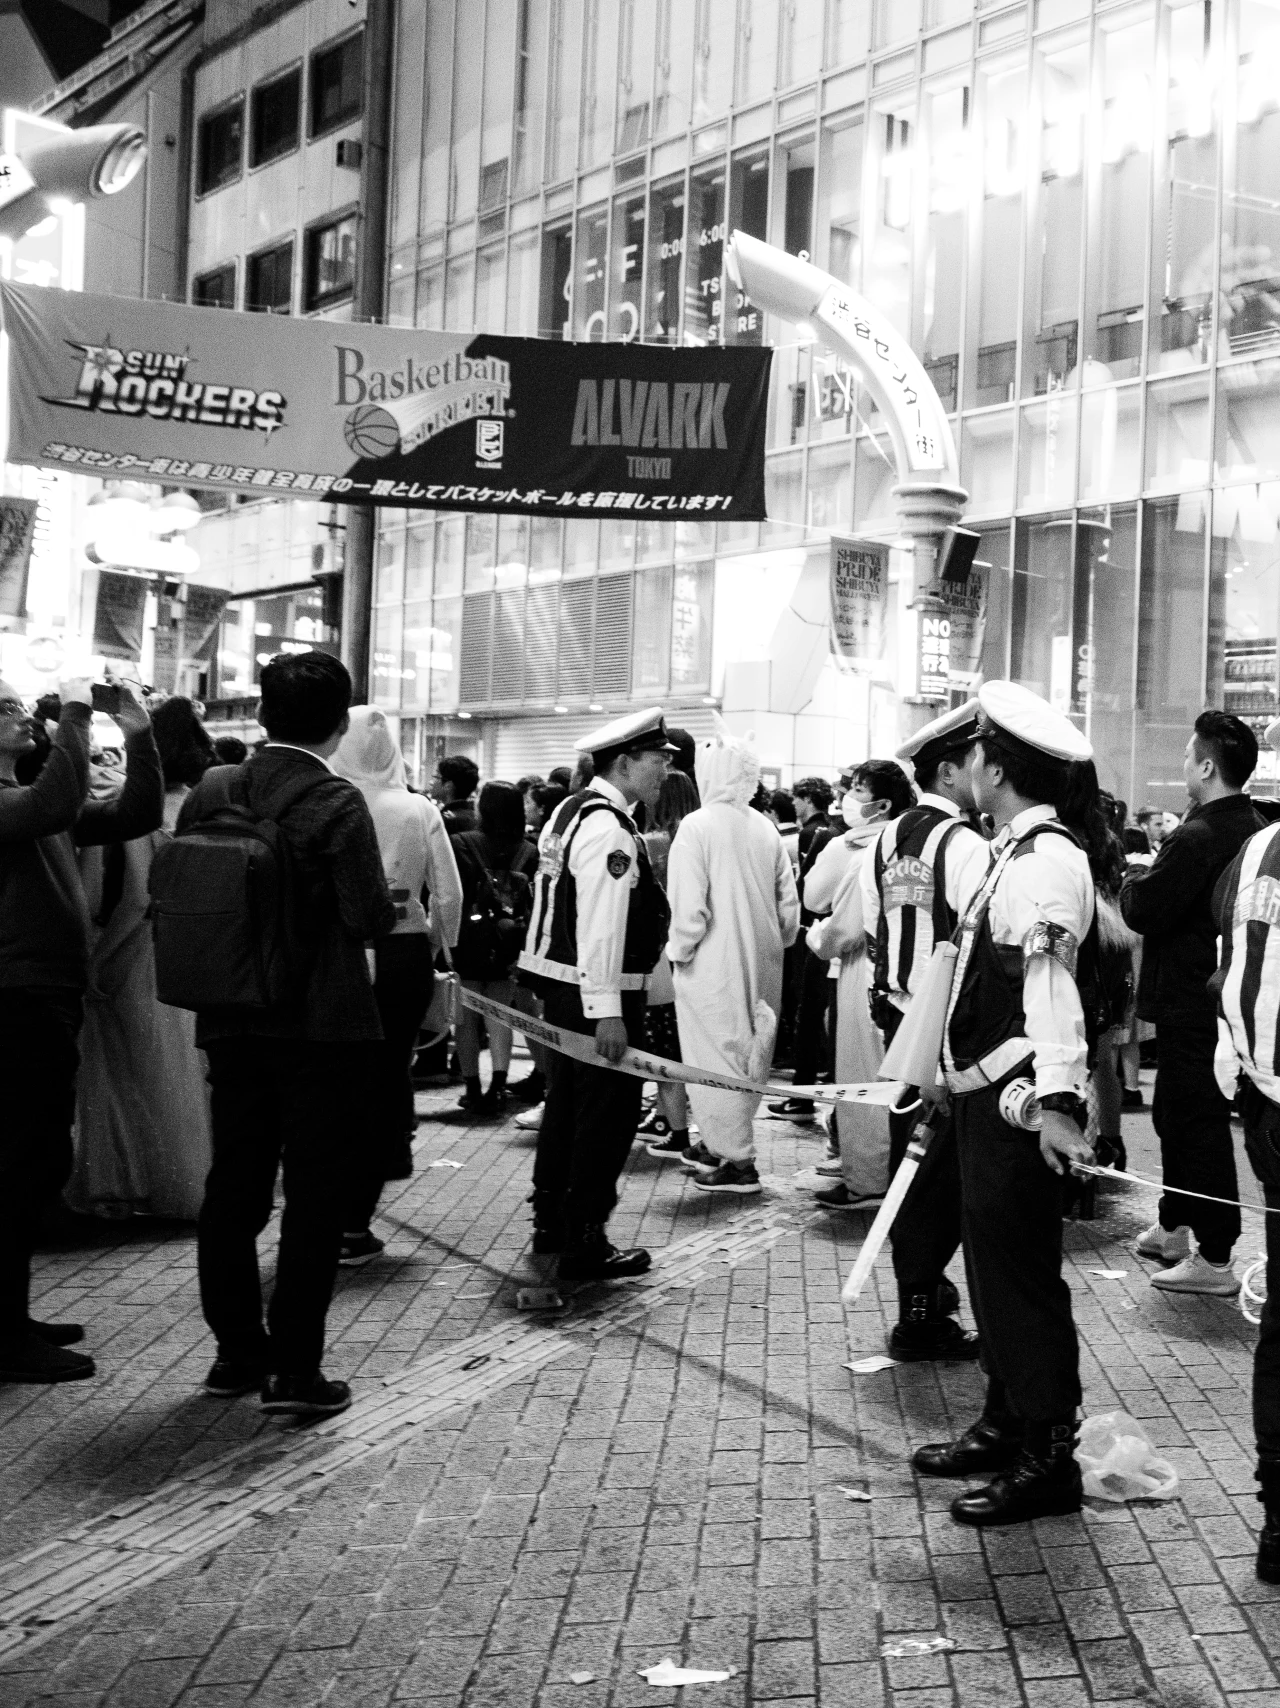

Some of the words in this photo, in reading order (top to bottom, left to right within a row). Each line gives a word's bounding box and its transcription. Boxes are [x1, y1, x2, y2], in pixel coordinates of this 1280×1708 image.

[125, 351, 182, 378] SUN
[335, 346, 506, 406] Basketball
[64, 343, 285, 432] ROCKERS
[571, 379, 731, 449] ALVARK
[627, 456, 671, 479] TOKYO
[882, 860, 932, 885] POICE
